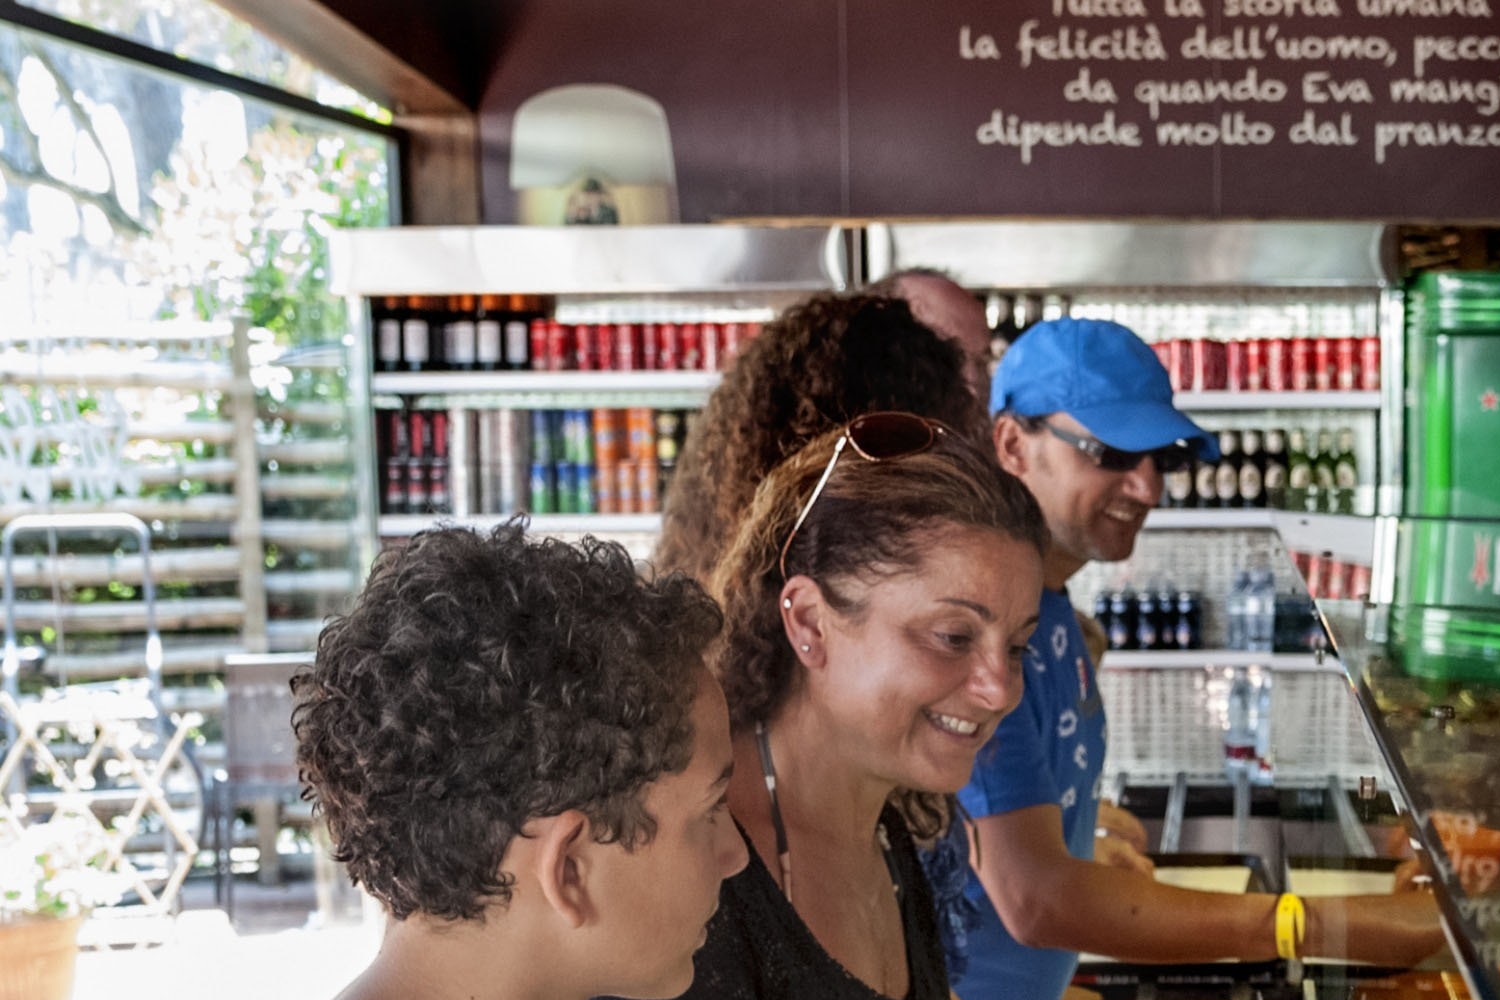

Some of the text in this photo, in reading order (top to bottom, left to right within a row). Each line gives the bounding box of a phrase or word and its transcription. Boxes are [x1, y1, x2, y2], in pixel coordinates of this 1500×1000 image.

[958, 26, 1000, 60] la
[1016, 20, 1168, 68] felicità
[1180, 24, 1398, 66] dell'uomo,
[1063, 66, 1118, 104] da
[1134, 66, 1288, 121] quando
[1302, 70, 1374, 104] Eva
[976, 108, 1142, 165] dipende
[1155, 111, 1275, 146] molto
[1288, 108, 1359, 146] dal
